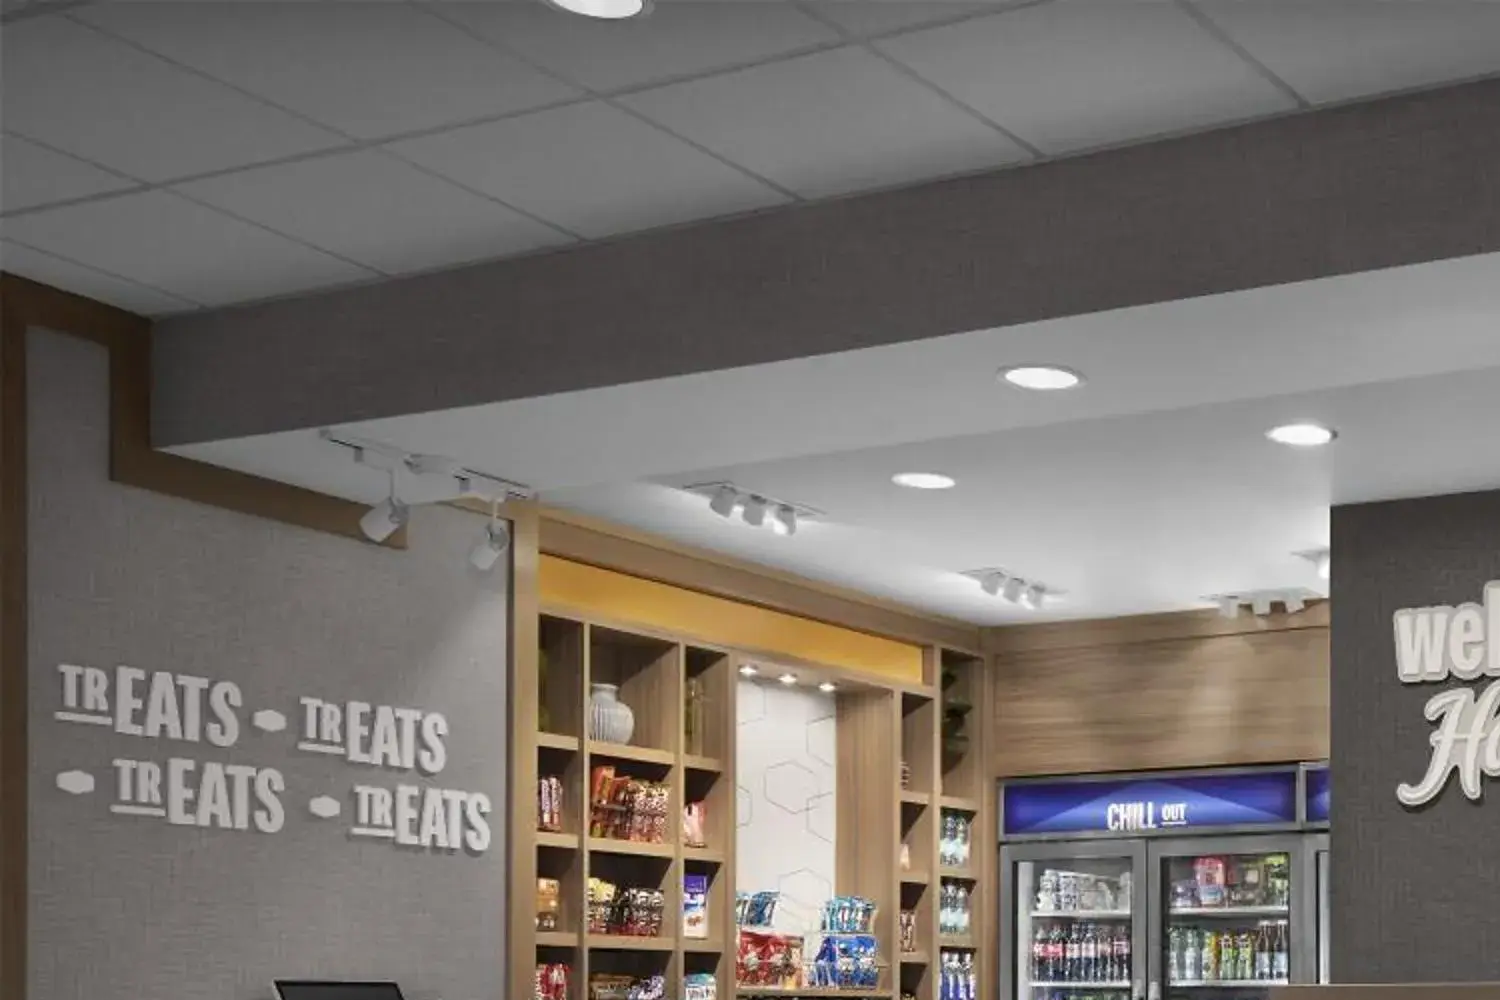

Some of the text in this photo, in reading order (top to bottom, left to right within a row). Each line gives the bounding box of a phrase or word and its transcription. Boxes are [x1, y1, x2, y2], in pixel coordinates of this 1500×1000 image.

[55, 664, 450, 773] TREATS TREATS
[110, 758, 286, 834] TREATS
[350, 785, 493, 852] TREATS
[1107, 801, 1187, 831] CHILL OUT
